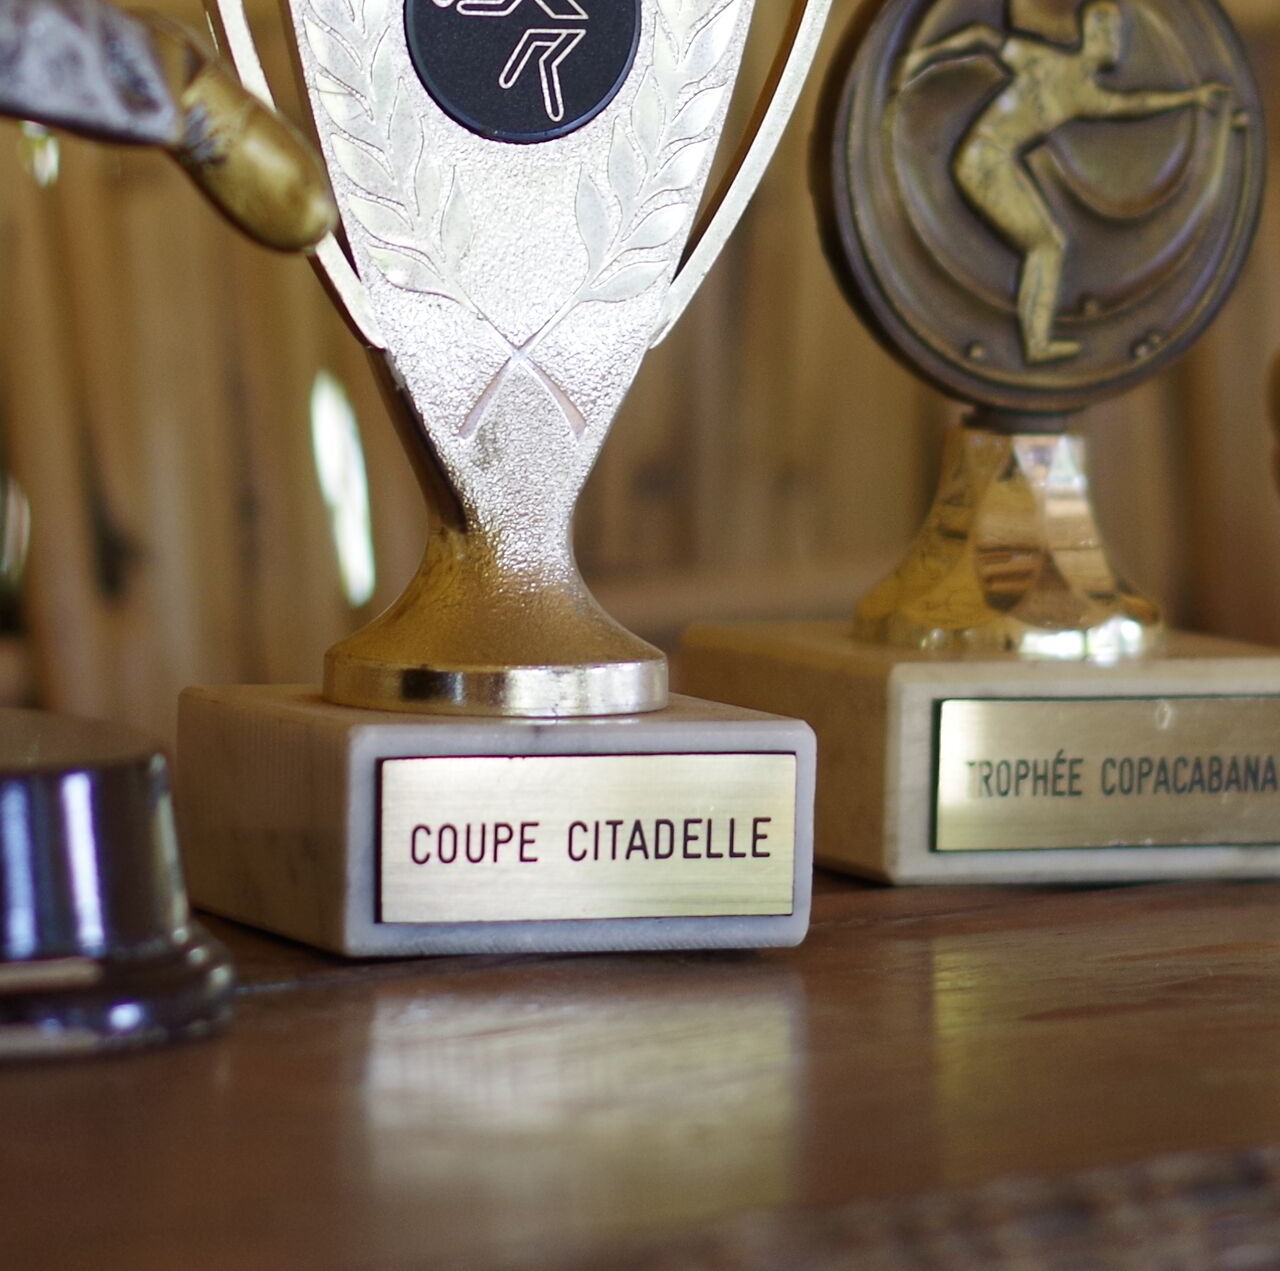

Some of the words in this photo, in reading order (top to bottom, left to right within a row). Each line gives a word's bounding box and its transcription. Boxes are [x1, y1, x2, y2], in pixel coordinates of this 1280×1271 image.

[965, 749, 1085, 799] TROPHÉE
[1100, 753, 1280, 797] COPACABANA
[410, 822, 540, 865] COUPE
[567, 816, 772, 861] CITADELLE
